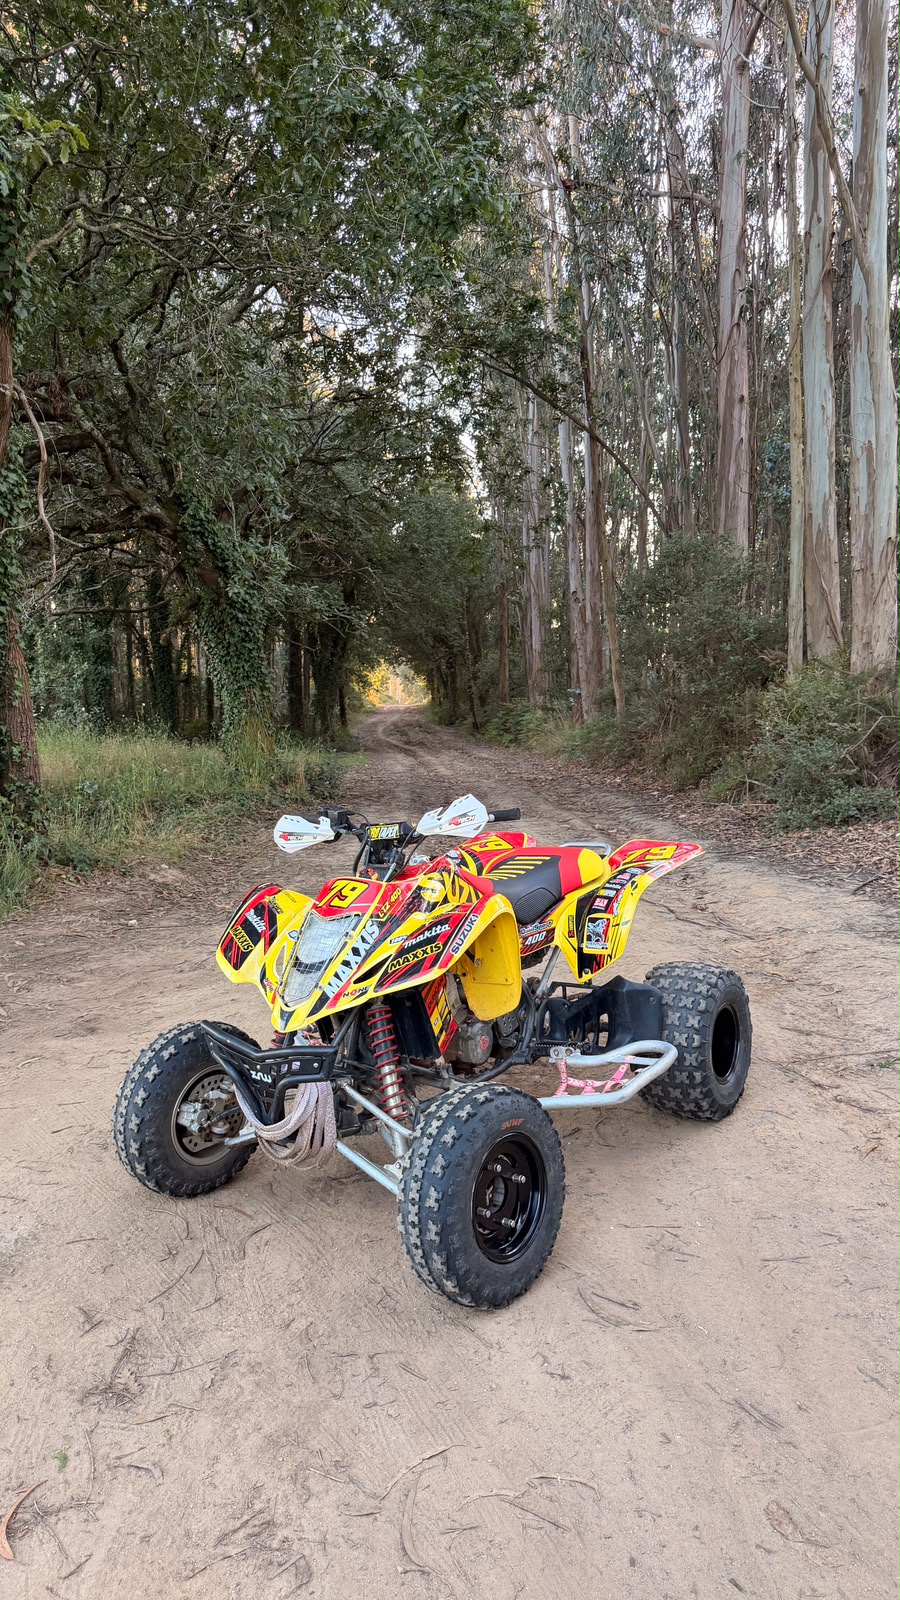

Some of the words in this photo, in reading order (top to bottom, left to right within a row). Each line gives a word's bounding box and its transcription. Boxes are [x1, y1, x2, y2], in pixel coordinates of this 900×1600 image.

[622, 845, 679, 864] 79
[317, 879, 369, 909] 79
[403, 924, 451, 948] makita
[451, 915, 479, 954] SUZUKI
[525, 931, 547, 946] 400
[324, 919, 380, 999] MAXXIS
[390, 944, 441, 971] MAXXIS
